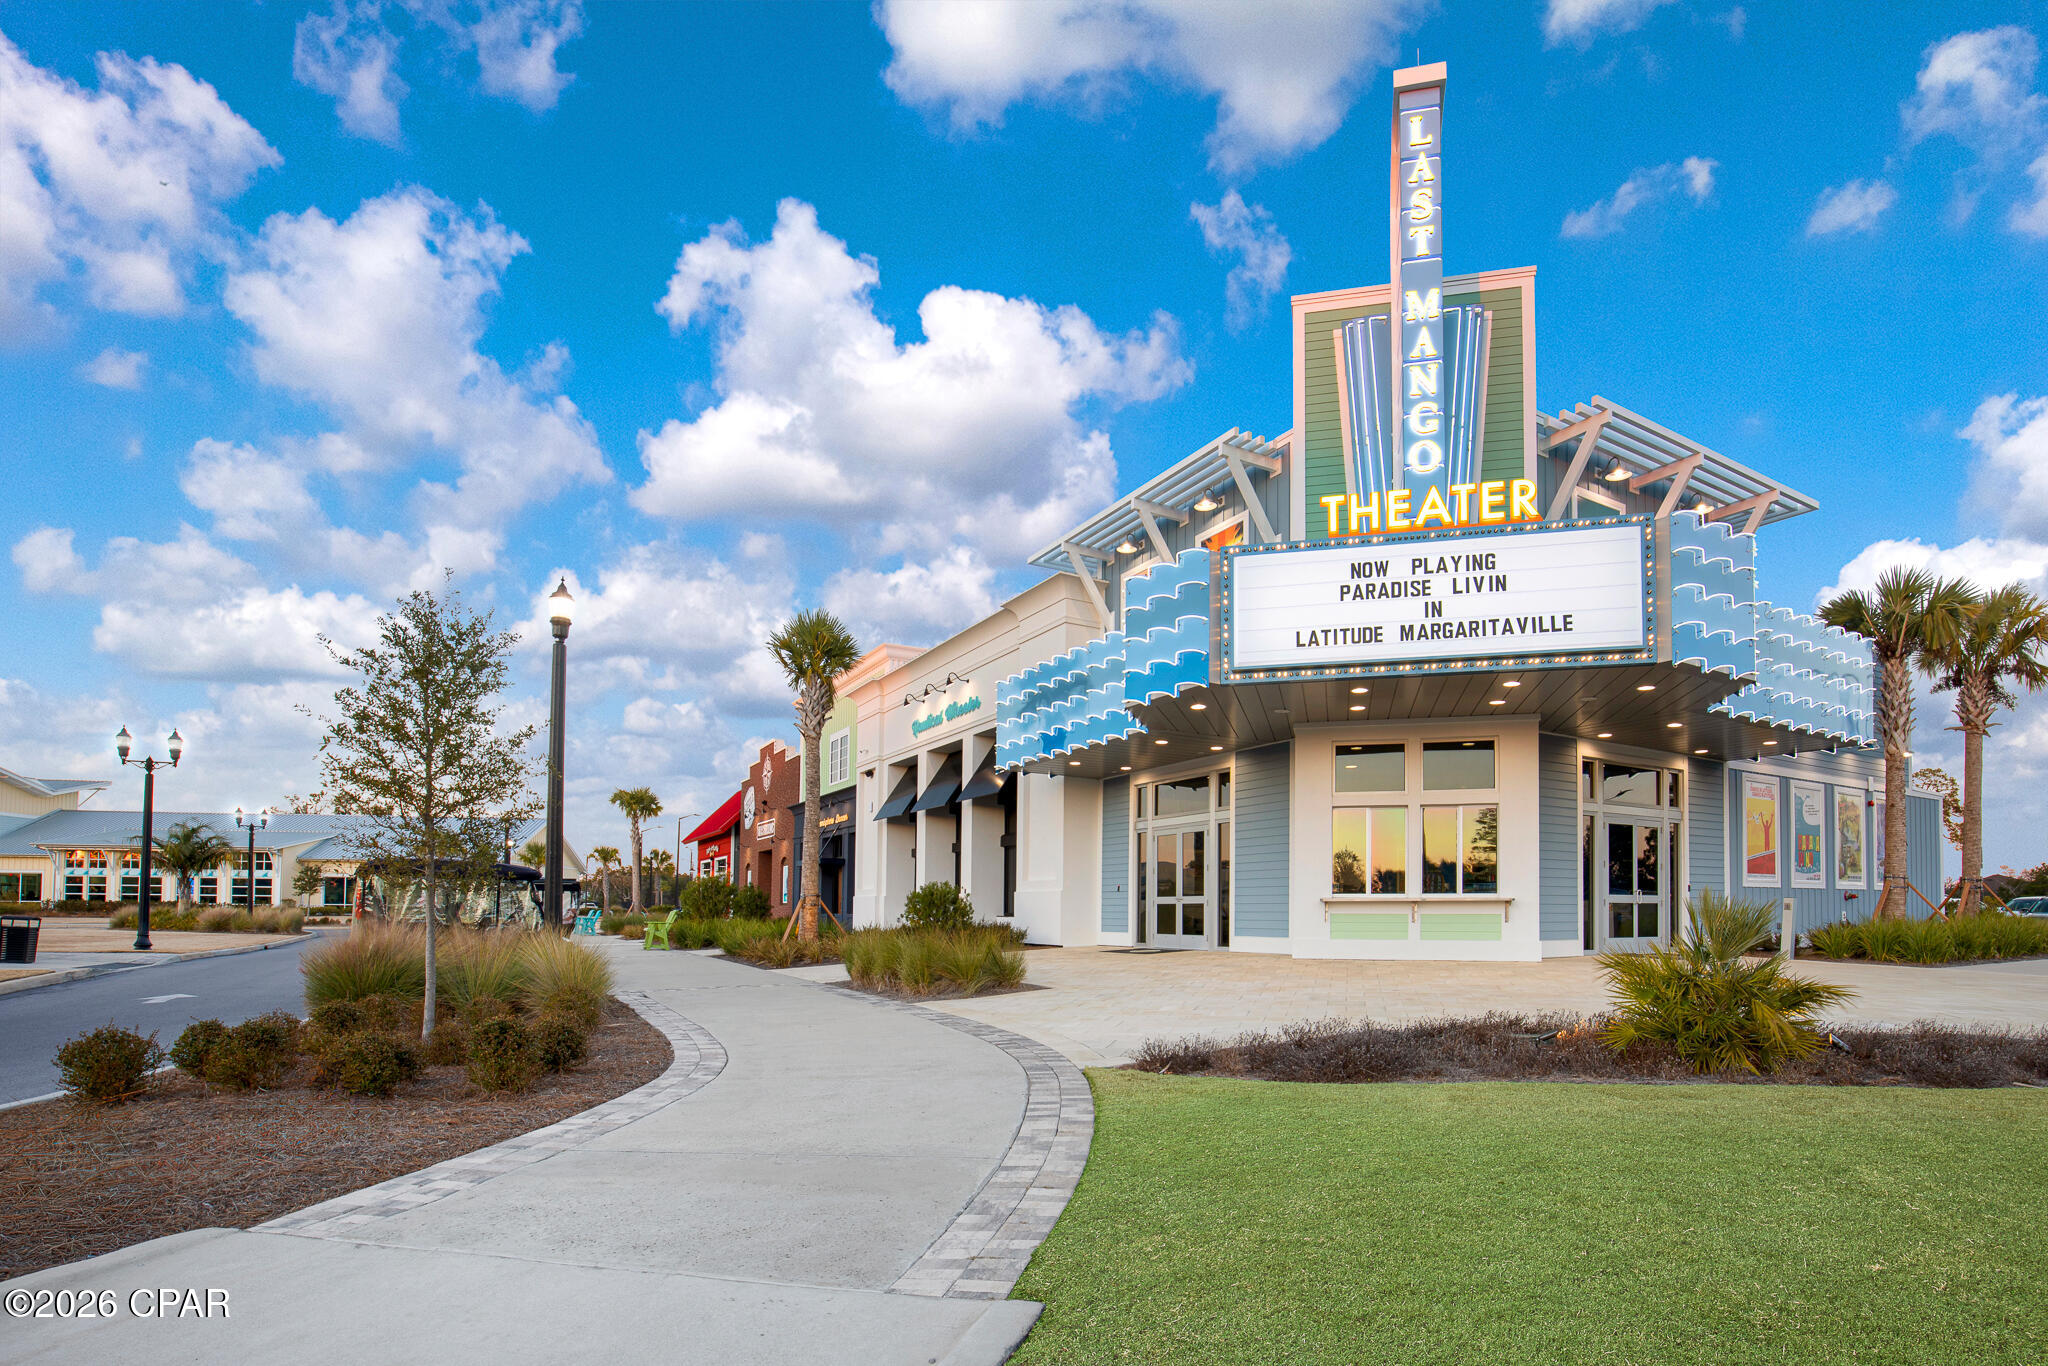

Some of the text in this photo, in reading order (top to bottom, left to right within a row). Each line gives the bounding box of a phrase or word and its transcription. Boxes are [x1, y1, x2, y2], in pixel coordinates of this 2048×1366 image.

[1404, 115, 1443, 473] LAST MANGO
[1320, 477, 1541, 535] THEATER
[1350, 553, 1496, 580] NOW PLAYING
[1340, 574, 1507, 602] PARADISE LIVIN
[1424, 600, 1442, 618] IN
[1296, 614, 1573, 648] LATITUDE MARGARITAVILLE
